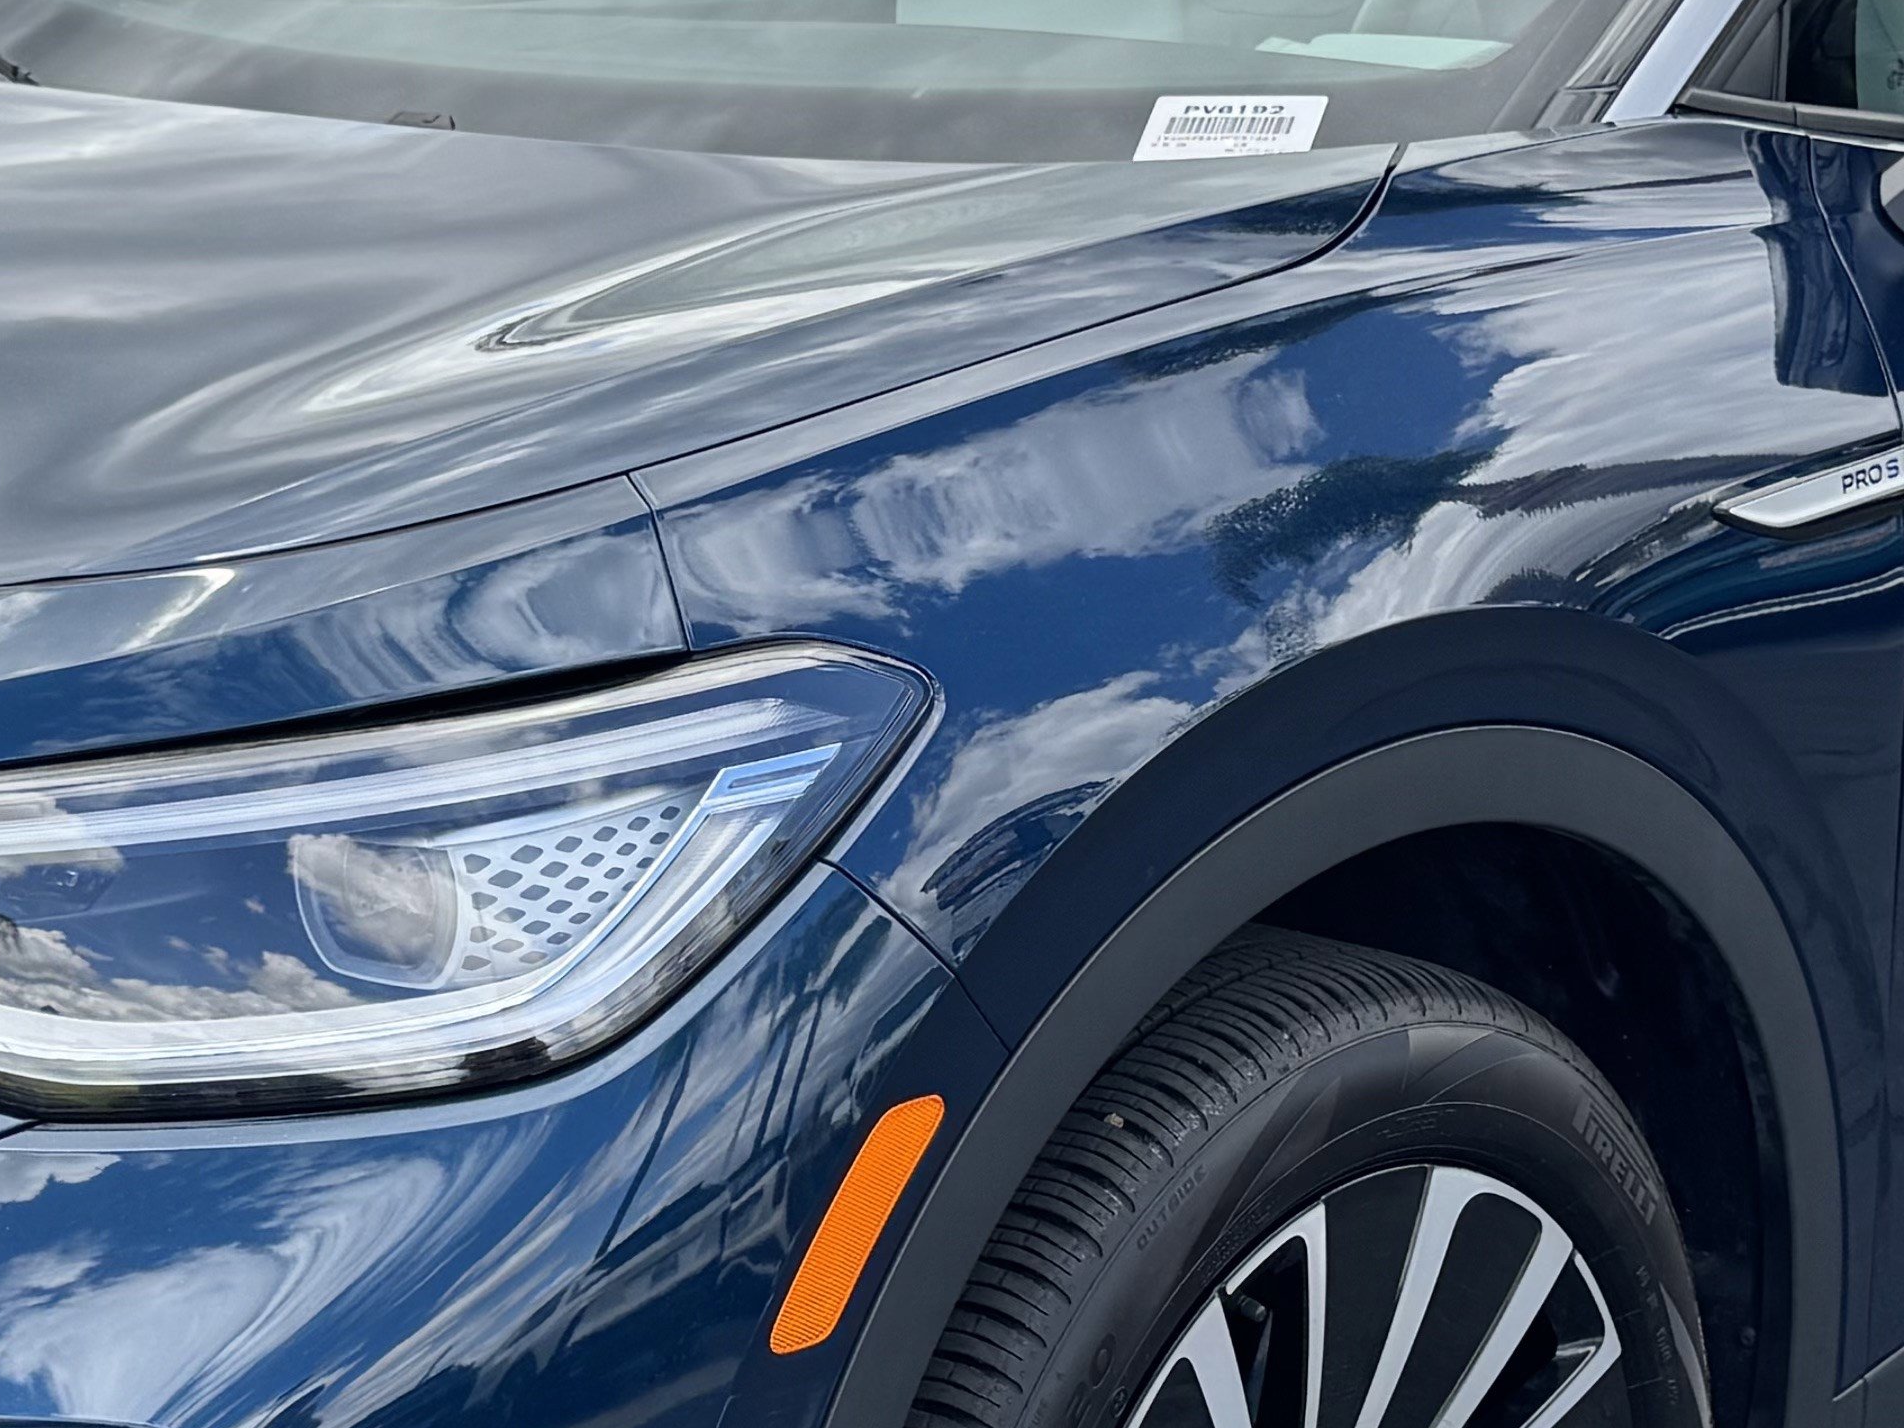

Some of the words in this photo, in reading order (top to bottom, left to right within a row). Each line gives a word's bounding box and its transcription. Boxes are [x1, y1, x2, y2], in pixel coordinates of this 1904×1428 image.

[1841, 464, 1882, 494] PRO
[1886, 457, 1900, 479] S
[1572, 1084, 1660, 1226] PIRELLI
